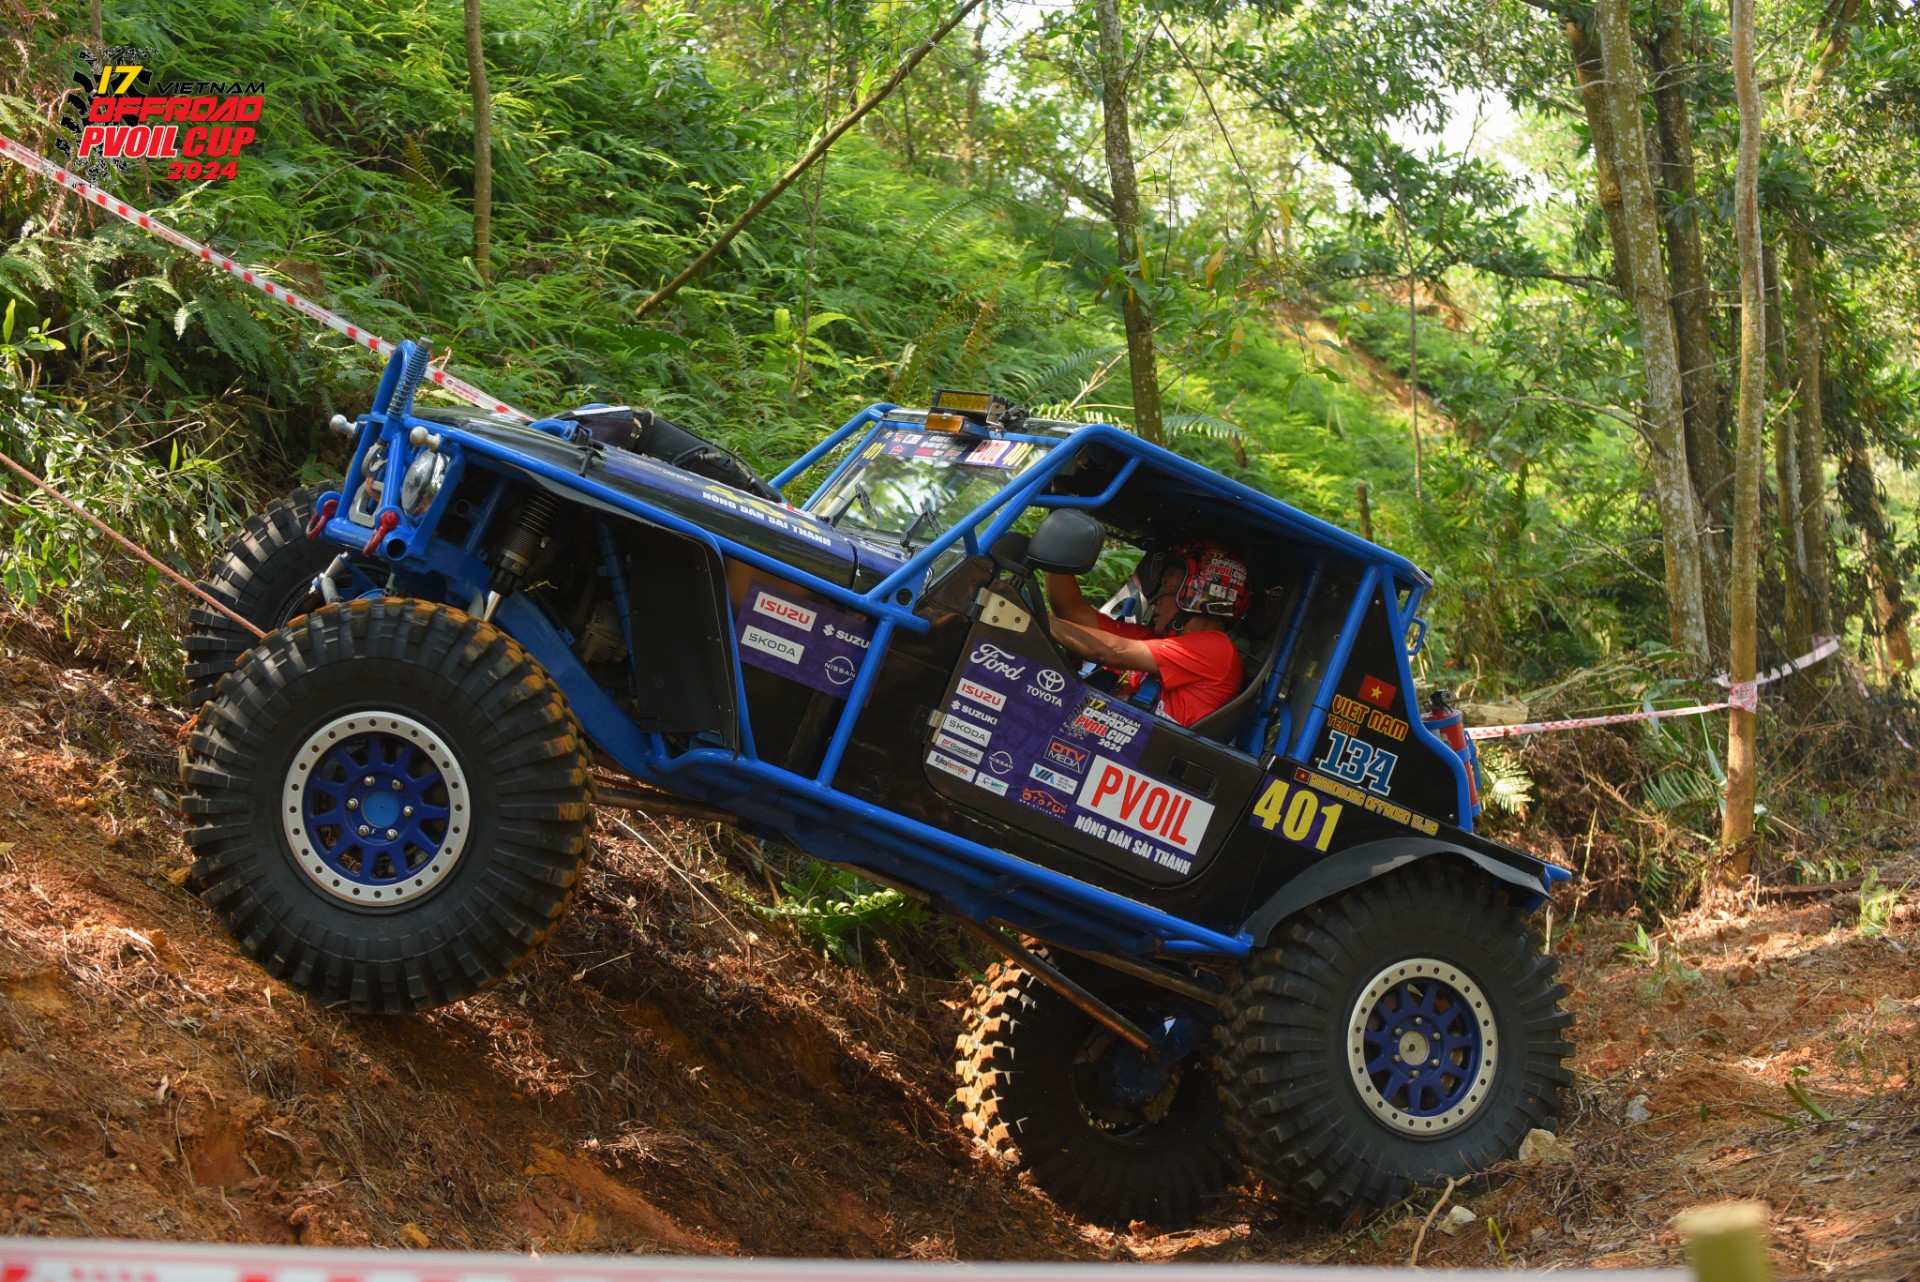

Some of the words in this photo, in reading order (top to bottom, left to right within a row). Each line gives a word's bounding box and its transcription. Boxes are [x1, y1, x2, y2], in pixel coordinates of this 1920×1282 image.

[759, 598, 812, 625] ISUZU
[748, 632, 796, 657] SKODA
[835, 629, 872, 649] SUZU
[824, 662, 856, 679] NISSAN
[970, 643, 1026, 681] Ford
[961, 683, 1002, 706] ISUZU
[1026, 684, 1063, 708] TOYOTA
[961, 704, 998, 726] SUZUKI
[1082, 706, 1141, 737] OFFROAD
[1089, 698, 1106, 710] 17
[1107, 709, 1141, 728] VIETNAM
[1327, 714, 1359, 737] TEAM
[1332, 694, 1369, 725] VIET
[1367, 710, 1409, 742] NAM
[948, 719, 986, 741] SKODA
[1074, 716, 1110, 738] PVOIL
[1105, 729, 1132, 745] CUP
[1051, 742, 1086, 762] OTV
[1097, 738, 1122, 752] 2024
[988, 755, 1014, 770] NISSAN
[1317, 729, 1399, 797] 134
[1090, 764, 1192, 846] PVOIL
[1252, 777, 1344, 853] 401
[1074, 814, 1107, 839] NÔNG
[1107, 825, 1133, 850] DÂN
